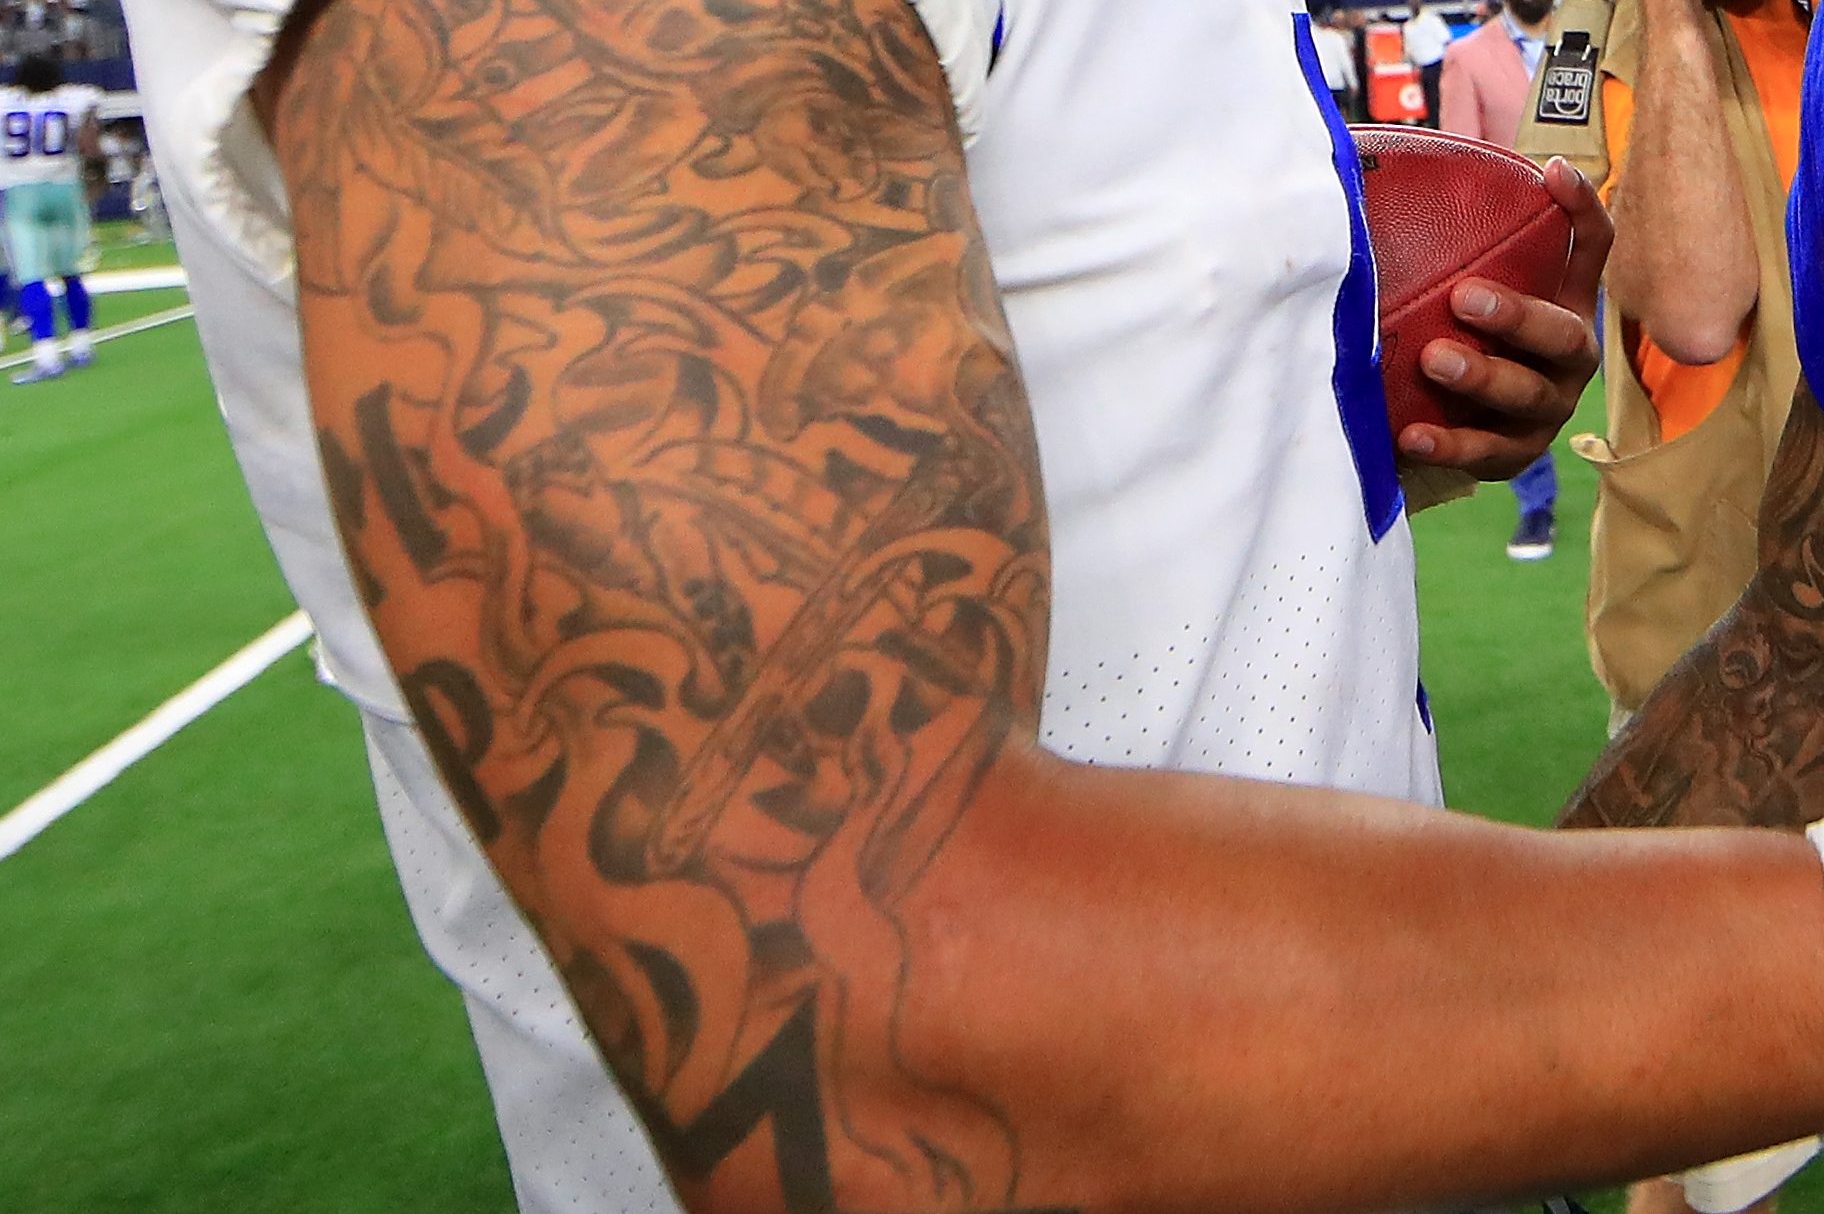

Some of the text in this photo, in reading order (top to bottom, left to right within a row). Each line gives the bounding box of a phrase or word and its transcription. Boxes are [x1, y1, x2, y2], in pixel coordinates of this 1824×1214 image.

[1547, 71, 1588, 87] brace
[1546, 87, 1584, 105] porta
[6, 111, 68, 157] 90
